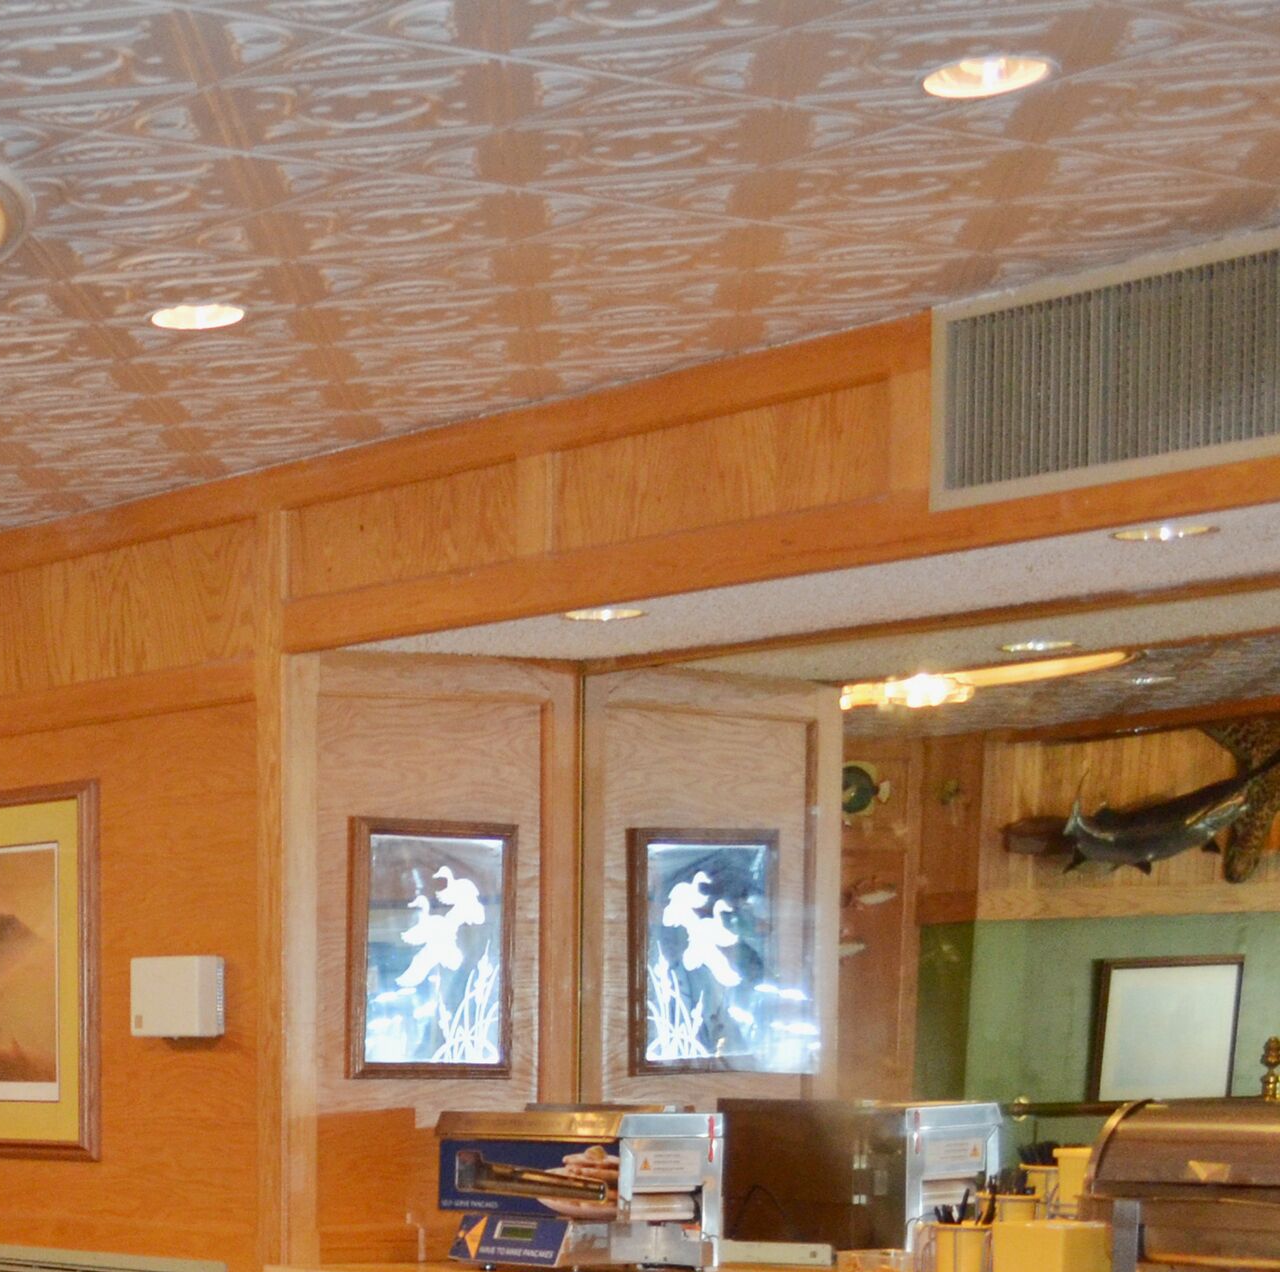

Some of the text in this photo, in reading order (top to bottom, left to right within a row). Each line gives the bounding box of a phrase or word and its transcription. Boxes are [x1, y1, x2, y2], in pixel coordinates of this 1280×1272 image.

[470, 1200, 499, 1208] PANCAKES
[497, 1247, 505, 1255] TO
[523, 1248, 554, 1259] PANCAKES
